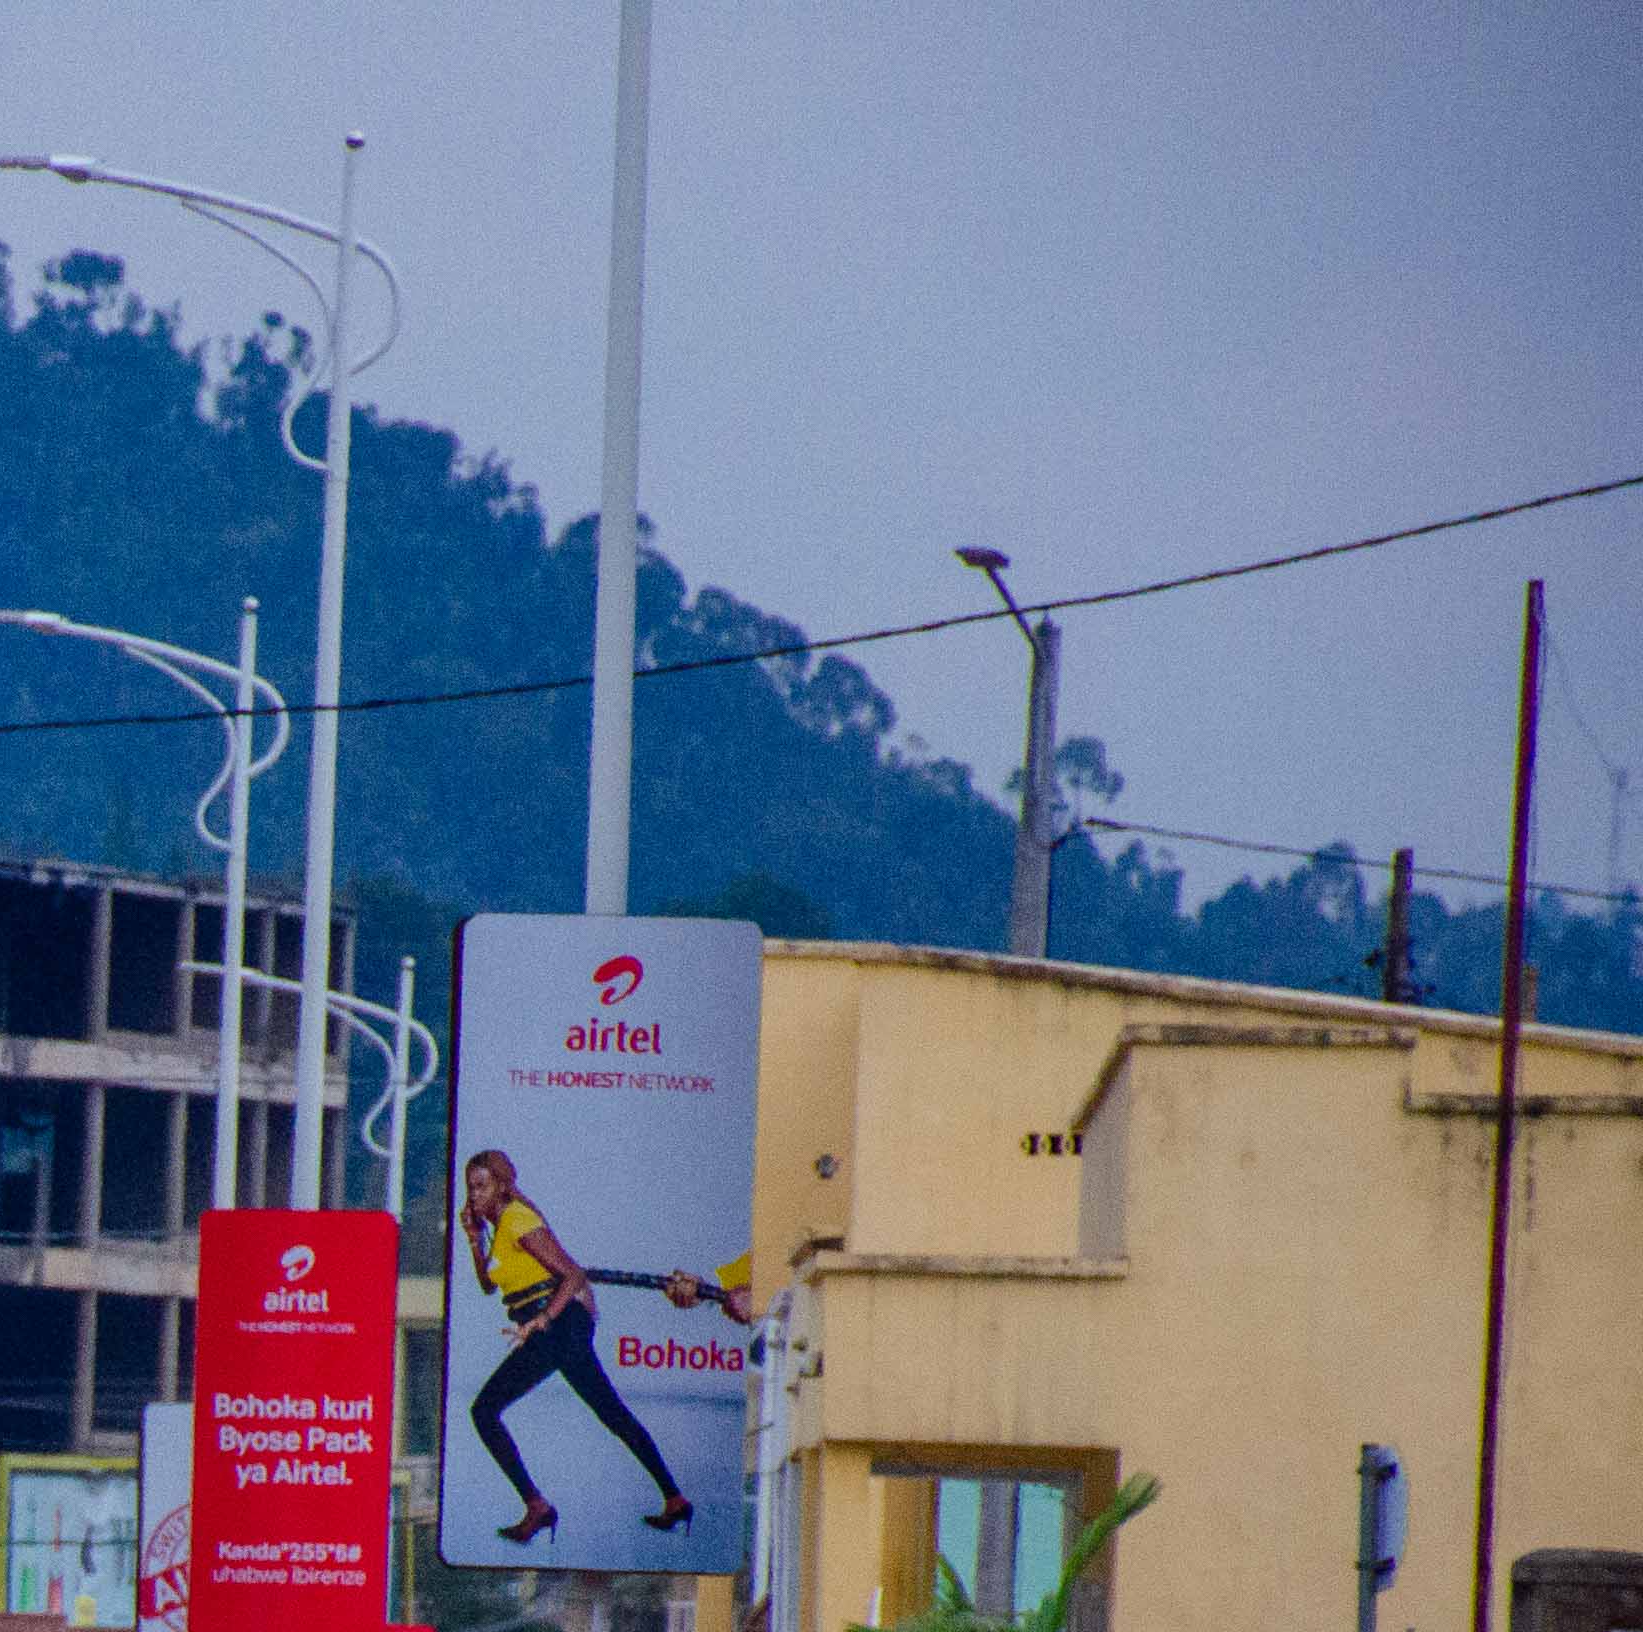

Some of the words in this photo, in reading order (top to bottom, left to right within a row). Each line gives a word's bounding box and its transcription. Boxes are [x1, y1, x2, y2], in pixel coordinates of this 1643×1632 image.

[565, 1017, 662, 1054] airtel
[508, 1070, 543, 1087] THE
[546, 1071, 625, 1088] HONEST
[629, 1073, 715, 1093] NETWORK
[264, 1286, 329, 1313] airtel
[618, 1336, 744, 1371] Bohoka
[214, 1392, 317, 1420] Bohoka
[322, 1394, 374, 1421] kuri
[218, 1425, 301, 1457] Byose
[306, 1427, 374, 1454] Pack
[235, 1462, 267, 1489] ya
[272, 1459, 354, 1486] Airtel.
[212, 1566, 288, 1584] uhabwe
